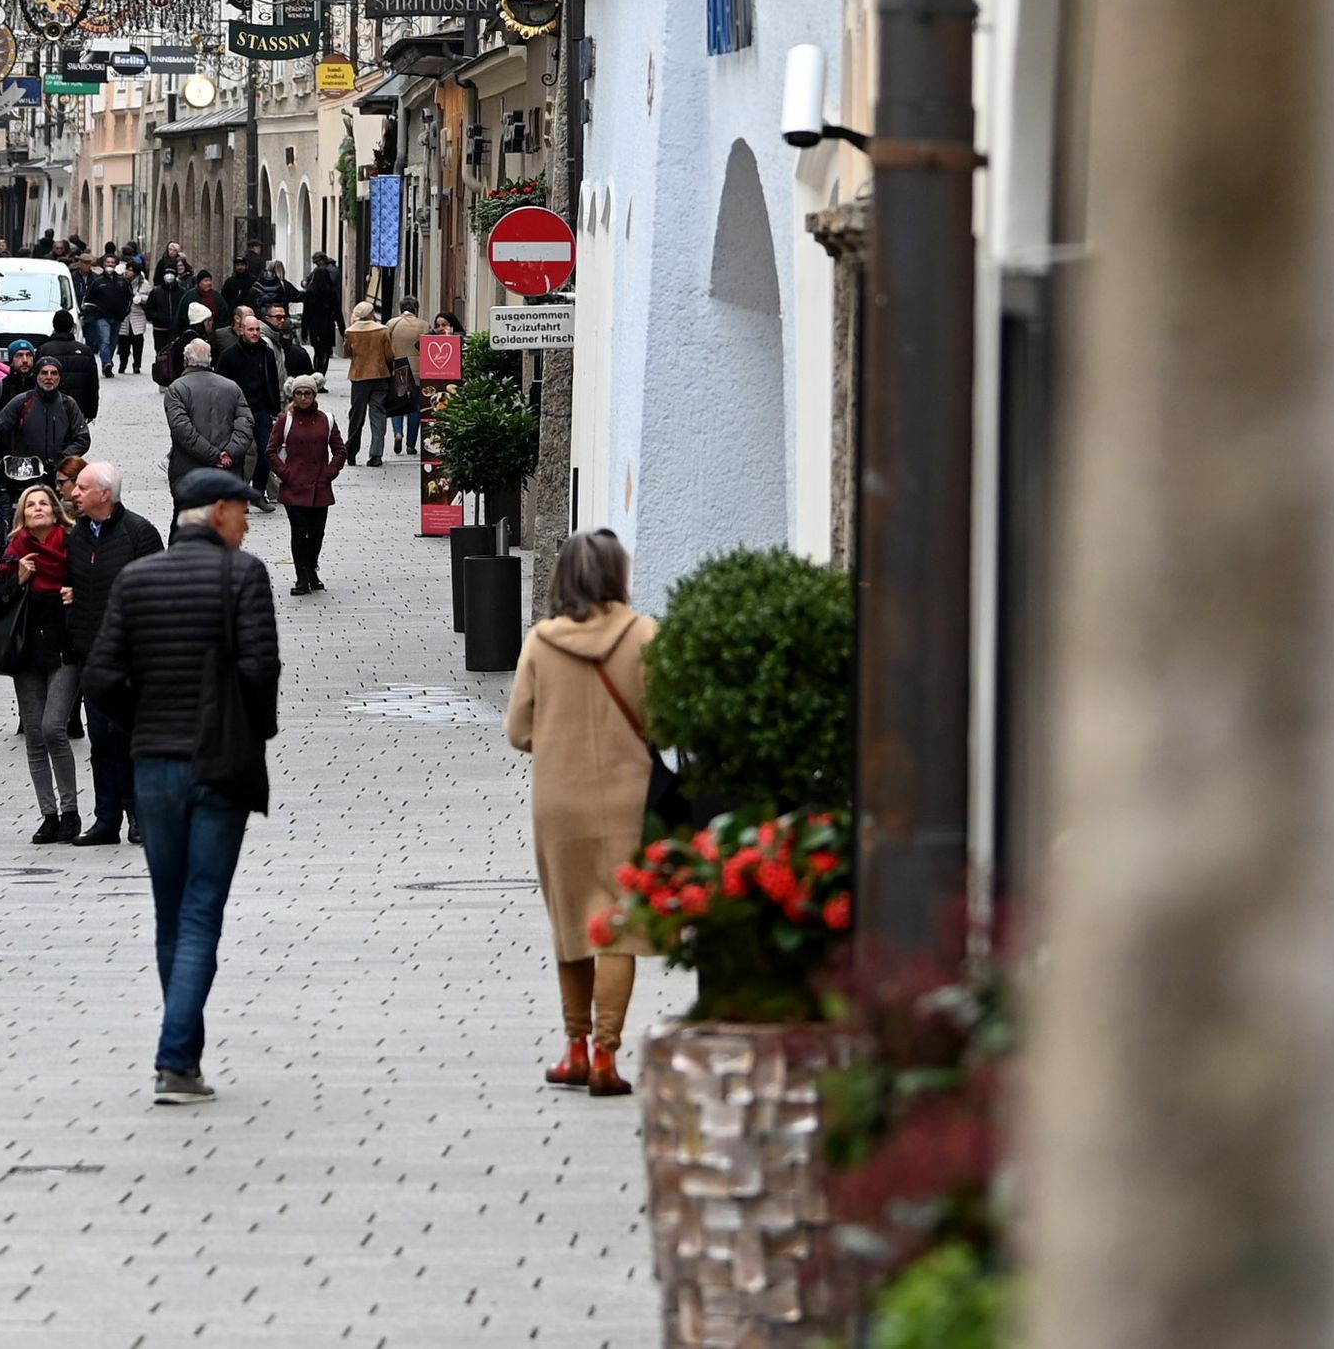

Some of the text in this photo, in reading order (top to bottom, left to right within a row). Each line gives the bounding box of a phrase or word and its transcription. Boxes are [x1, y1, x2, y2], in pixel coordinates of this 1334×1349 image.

[236, 31, 312, 51] STASSNY
[114, 56, 145, 65] Berlitz
[66, 63, 106, 71] SWAROVSKI
[495, 312, 570, 322] ausgenommen
[492, 334, 574, 345] Goldener Hirsch
